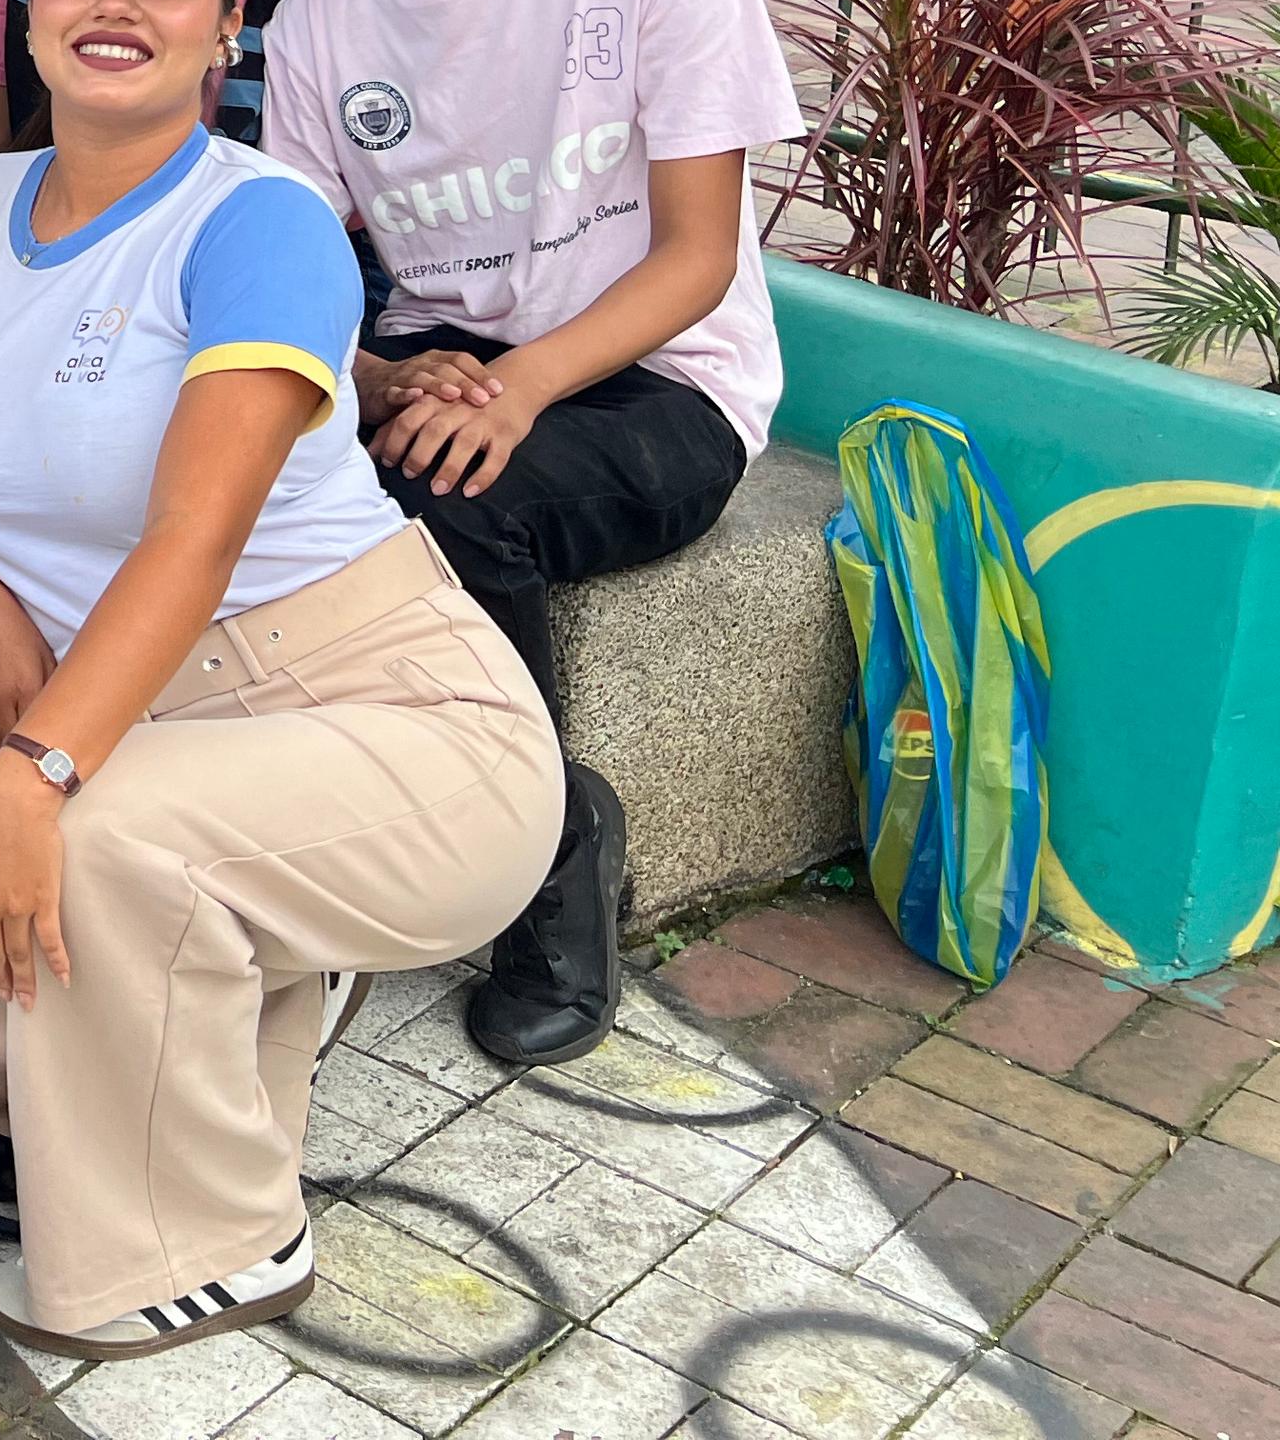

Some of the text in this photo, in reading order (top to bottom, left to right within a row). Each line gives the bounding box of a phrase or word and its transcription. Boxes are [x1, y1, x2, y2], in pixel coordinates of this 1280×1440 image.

[594, 199, 639, 222] Series
[395, 251, 516, 281] KEEPING IT SPORTY
[55, 369, 107, 383] tu voz
[899, 736, 935, 753] EPS
